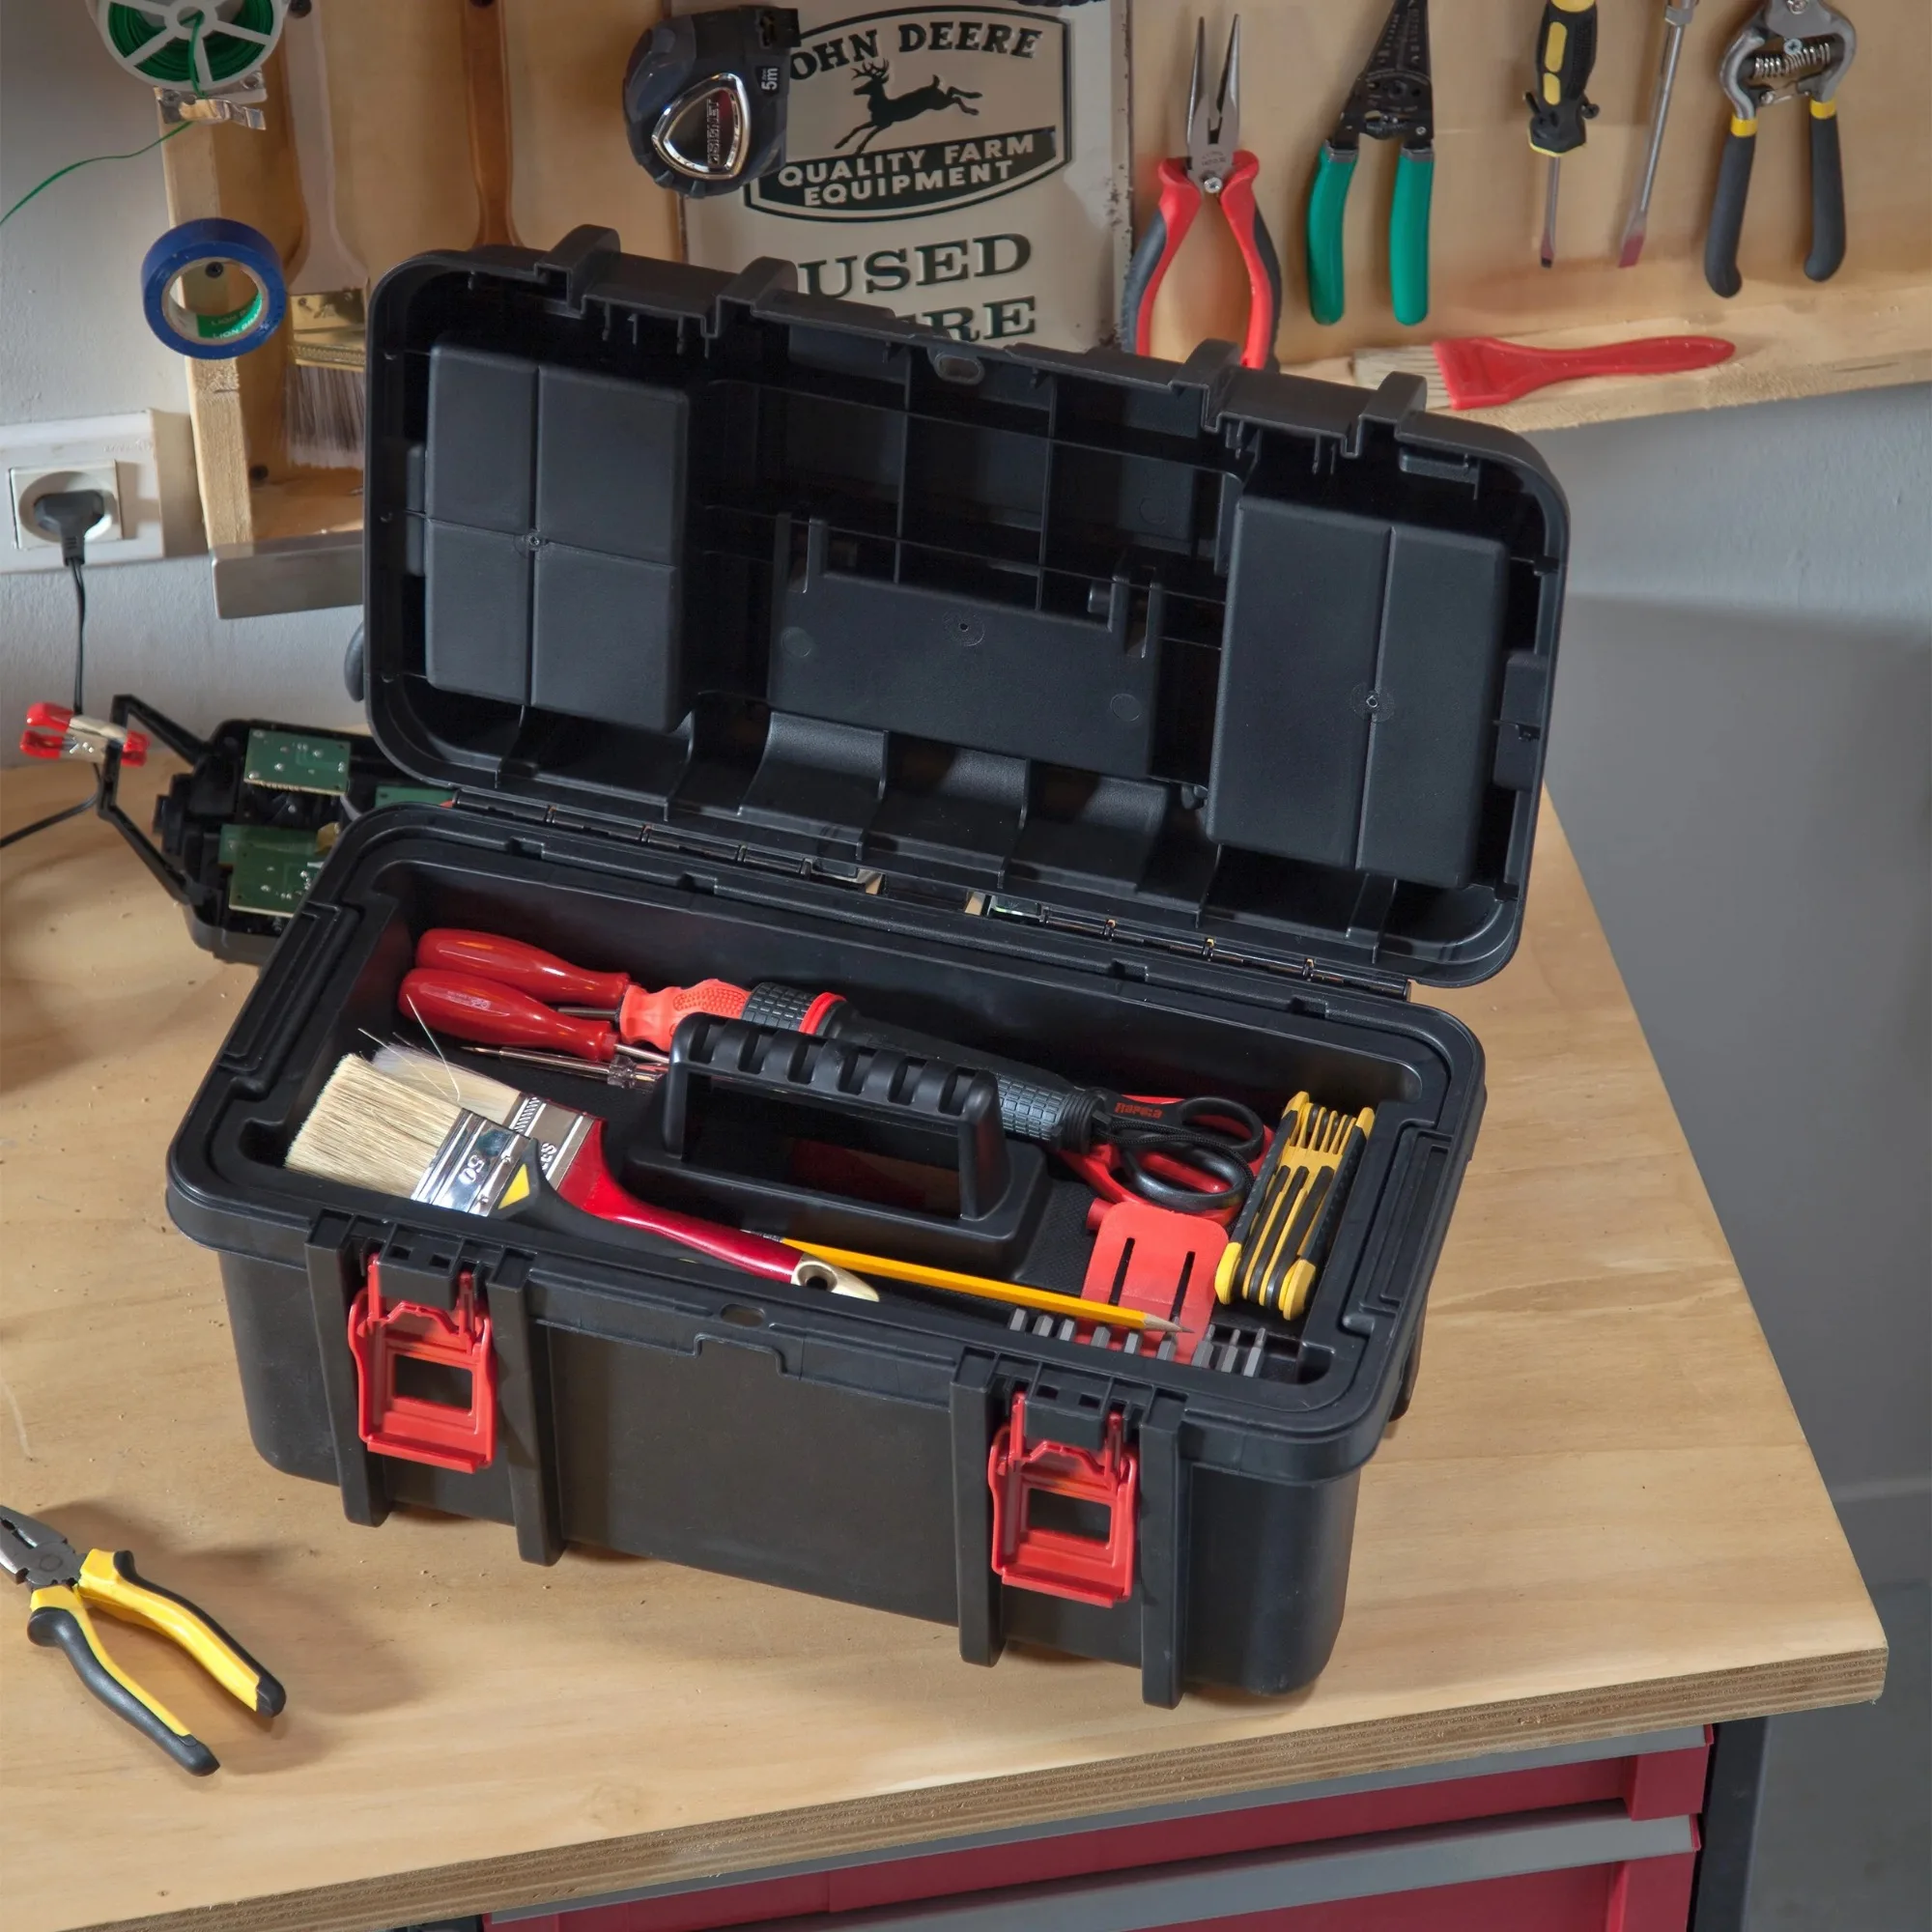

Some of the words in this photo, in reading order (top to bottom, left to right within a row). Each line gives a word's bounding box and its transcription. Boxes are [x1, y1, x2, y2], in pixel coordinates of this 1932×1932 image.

[789, 28, 879, 81] OHN
[897, 21, 1043, 59] DEERE
[760, 68, 779, 91] 5m
[778, 148, 925, 187] QUALITY
[944, 134, 1034, 165] FARM
[804, 159, 1013, 208] EQUIPMENT
[798, 233, 1032, 299] USED
[458, 1154, 485, 1185] 50
